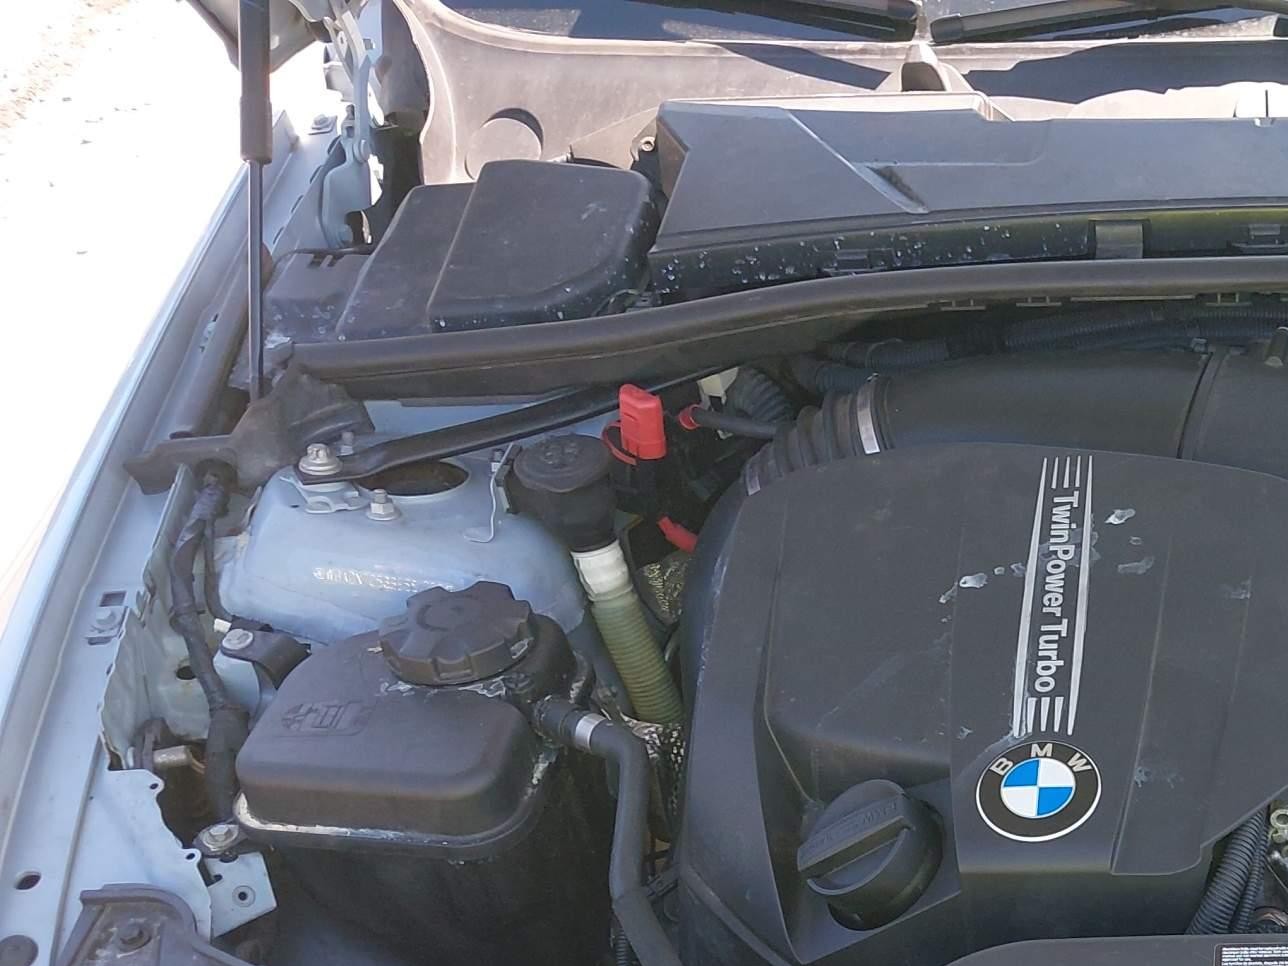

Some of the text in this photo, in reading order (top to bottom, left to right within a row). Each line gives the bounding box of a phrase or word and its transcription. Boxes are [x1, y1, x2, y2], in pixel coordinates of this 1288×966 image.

[1034, 490, 1079, 693] TwinPower Turbo
[989, 742, 1094, 776] BMW
